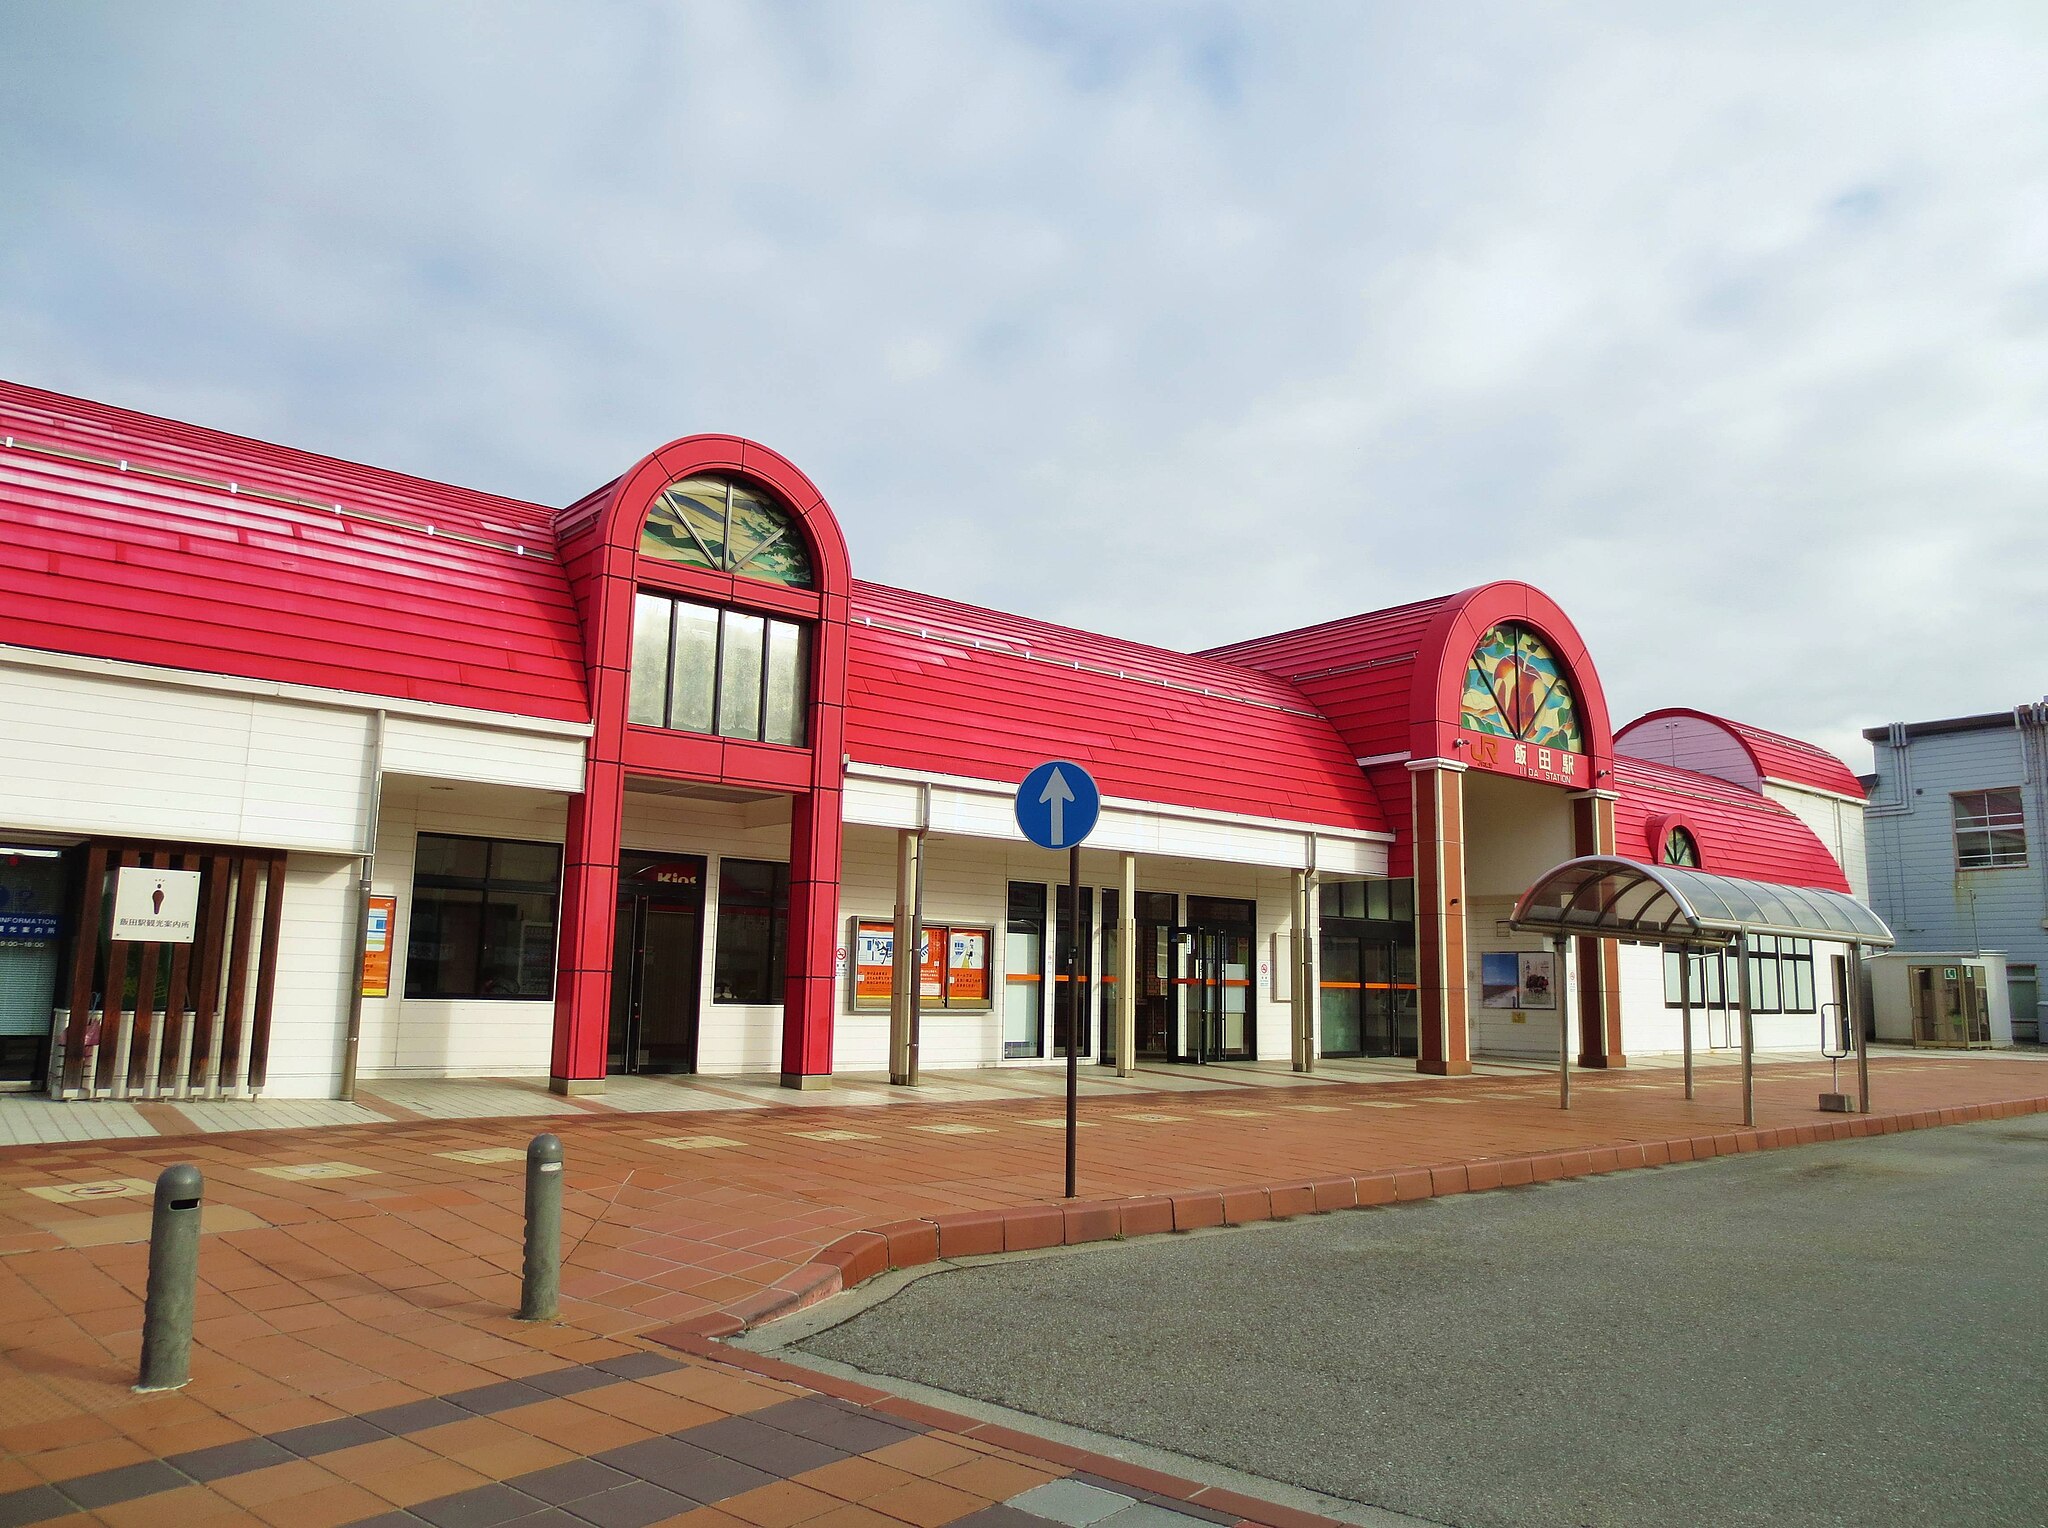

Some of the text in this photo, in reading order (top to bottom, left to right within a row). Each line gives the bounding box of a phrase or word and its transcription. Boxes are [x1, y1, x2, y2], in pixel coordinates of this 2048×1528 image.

[1471, 736, 1498, 764] JR
[1514, 743, 1575, 775] 飯田駅
[1545, 772, 1571, 784] STATION
[119, 918, 190, 929] 飯田駅観光案内所
